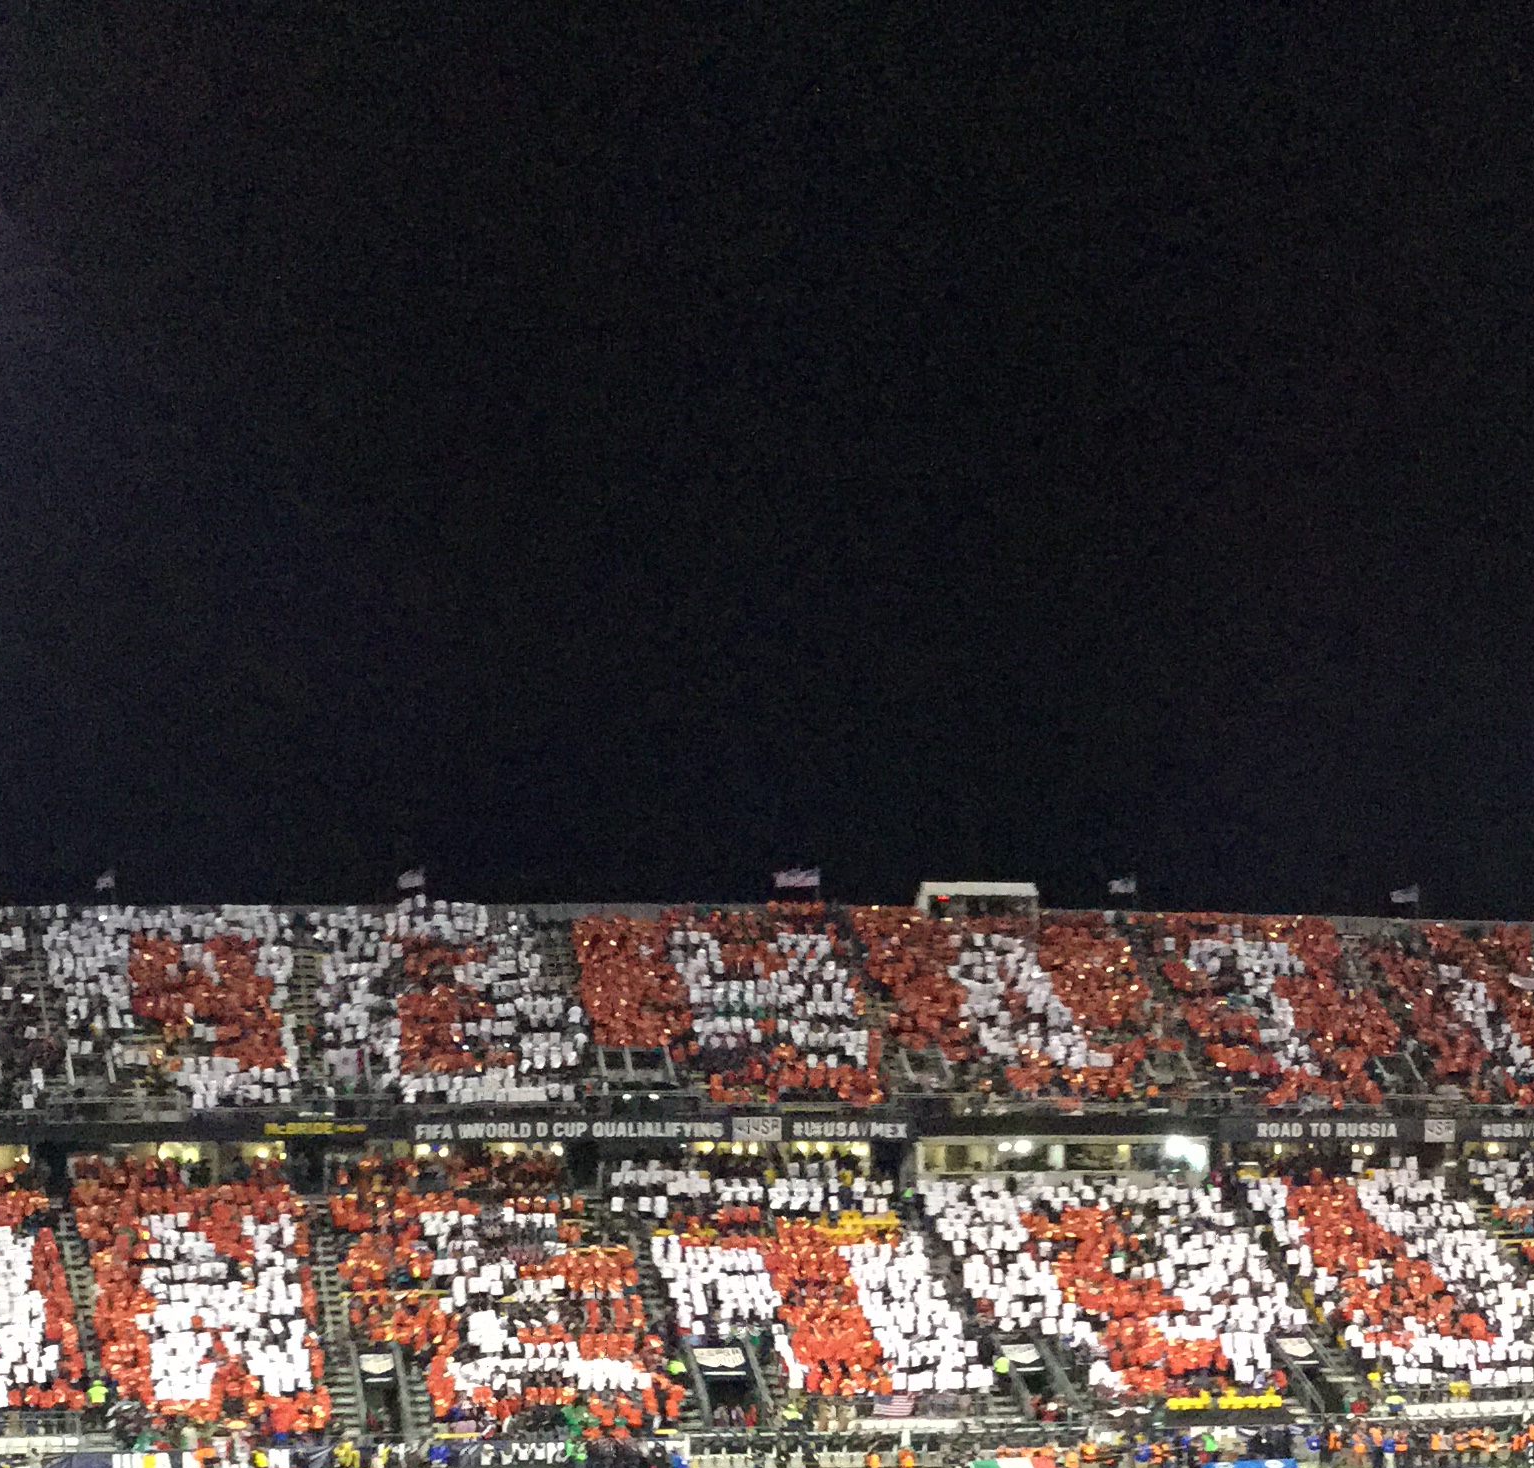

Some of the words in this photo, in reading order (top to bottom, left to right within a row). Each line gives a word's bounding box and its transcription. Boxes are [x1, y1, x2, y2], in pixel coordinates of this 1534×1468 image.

[415, 1124, 452, 1140] FIFA
[553, 1122, 588, 1138] CUP
[1257, 1122, 1303, 1138] ROAD
[1309, 1122, 1330, 1138] TO
[1336, 1122, 1398, 1138] RUSSIA
